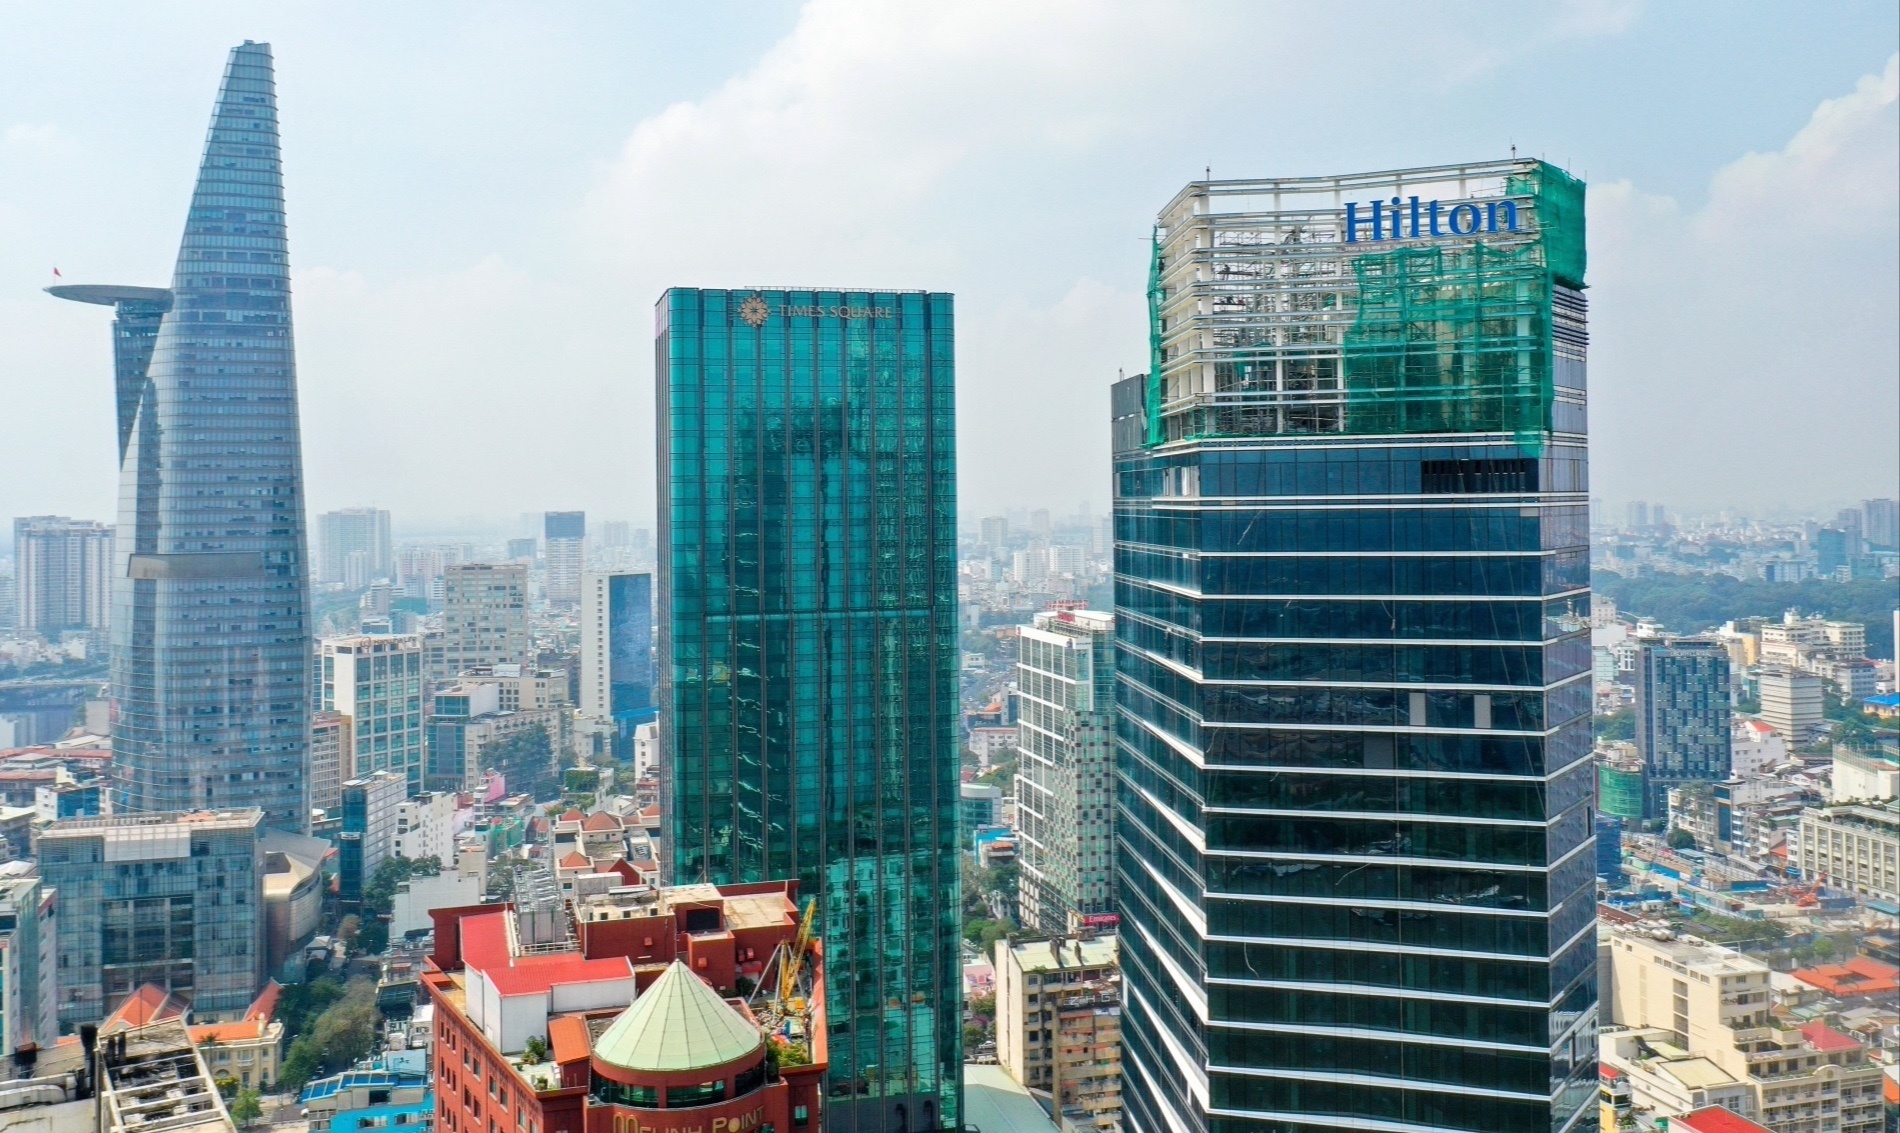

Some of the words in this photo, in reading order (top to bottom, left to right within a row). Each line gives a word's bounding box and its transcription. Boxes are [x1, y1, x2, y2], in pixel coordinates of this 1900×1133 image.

[1344, 195, 1519, 243] Hilton
[778, 304, 825, 317] TIMES
[829, 305, 893, 320] SQUARE
[712, 1105, 765, 1133] POINT
